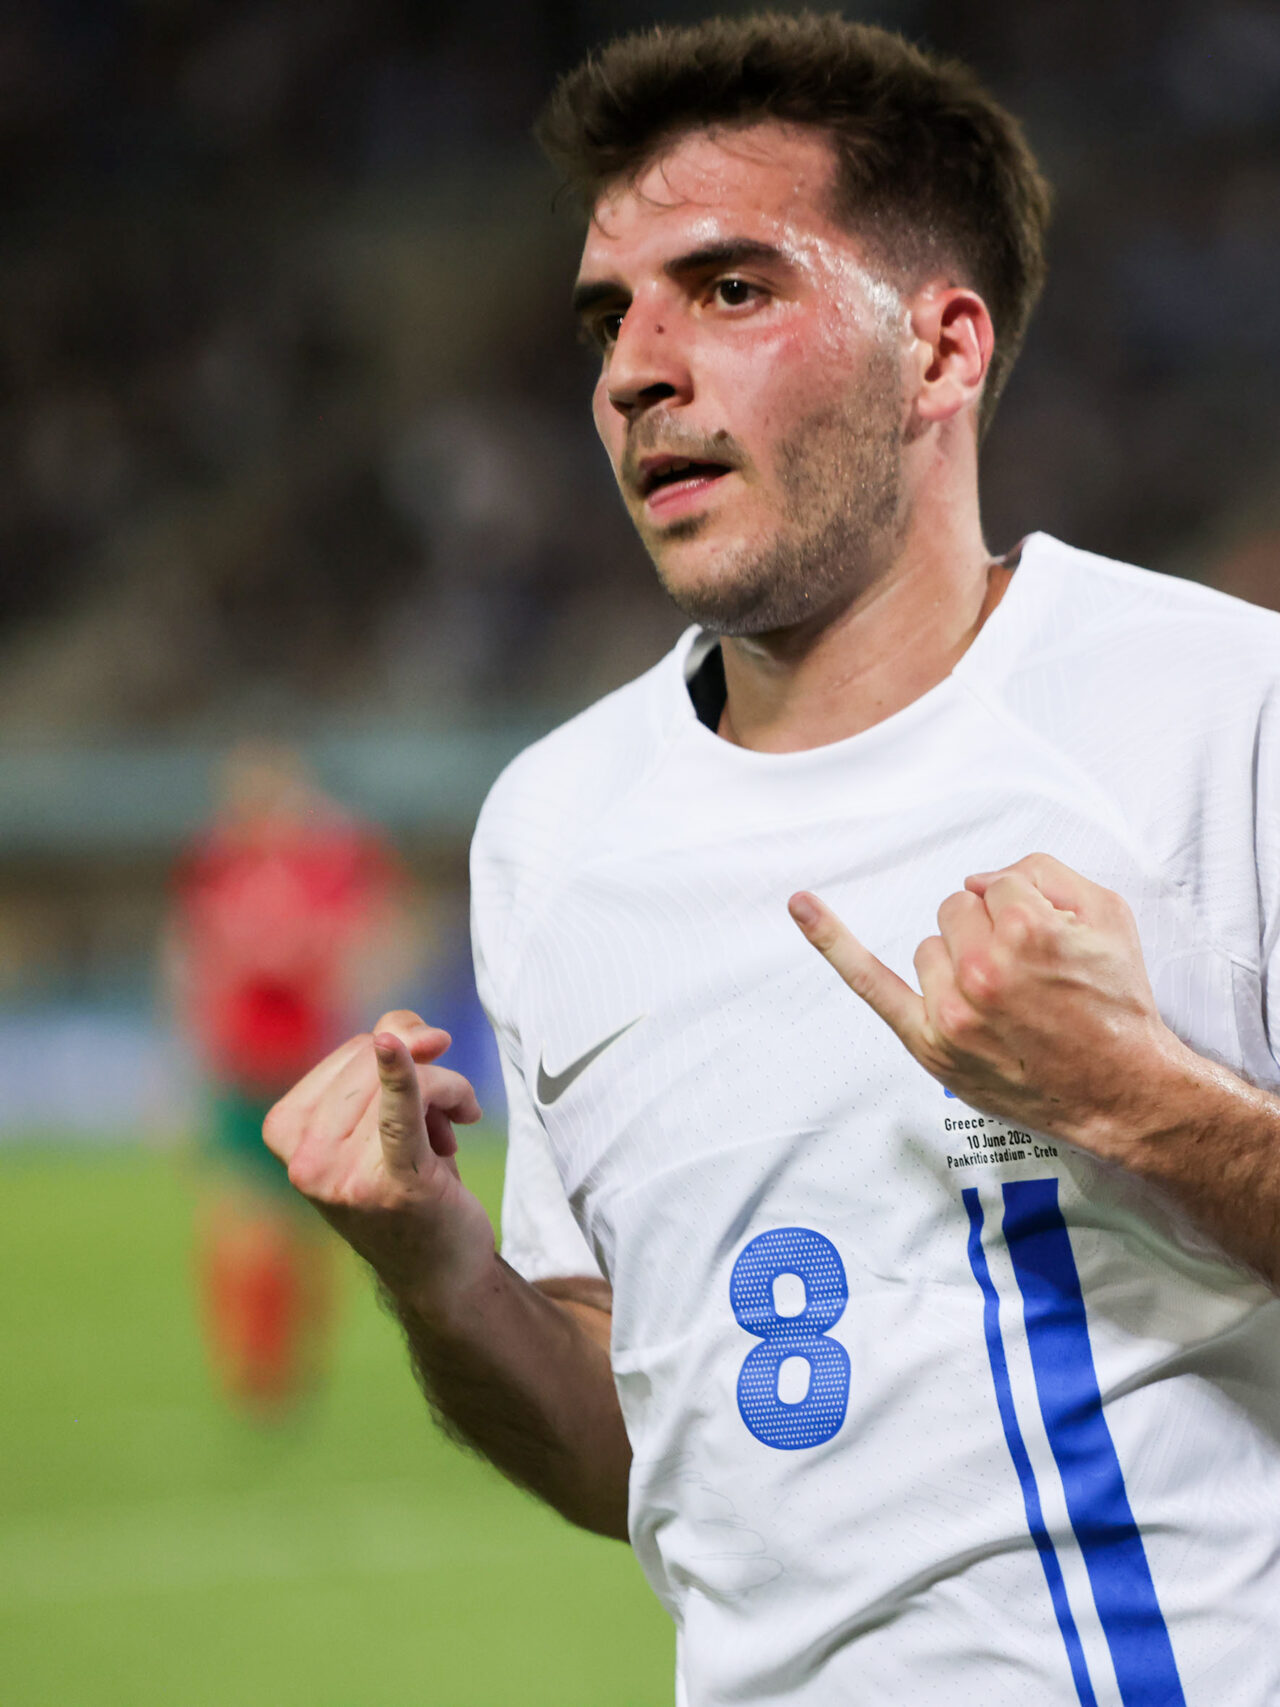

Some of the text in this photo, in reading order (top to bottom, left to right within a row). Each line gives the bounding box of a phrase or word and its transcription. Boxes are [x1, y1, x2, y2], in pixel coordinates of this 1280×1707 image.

[945, 1118, 985, 1131] Greece
[967, 1130, 1032, 1149] 10 June 2025
[947, 1152, 988, 1168] Pankritio
[990, 1149, 1026, 1164] stadium
[1034, 1146, 1058, 1158] Crete
[729, 1227, 851, 1450] 8
